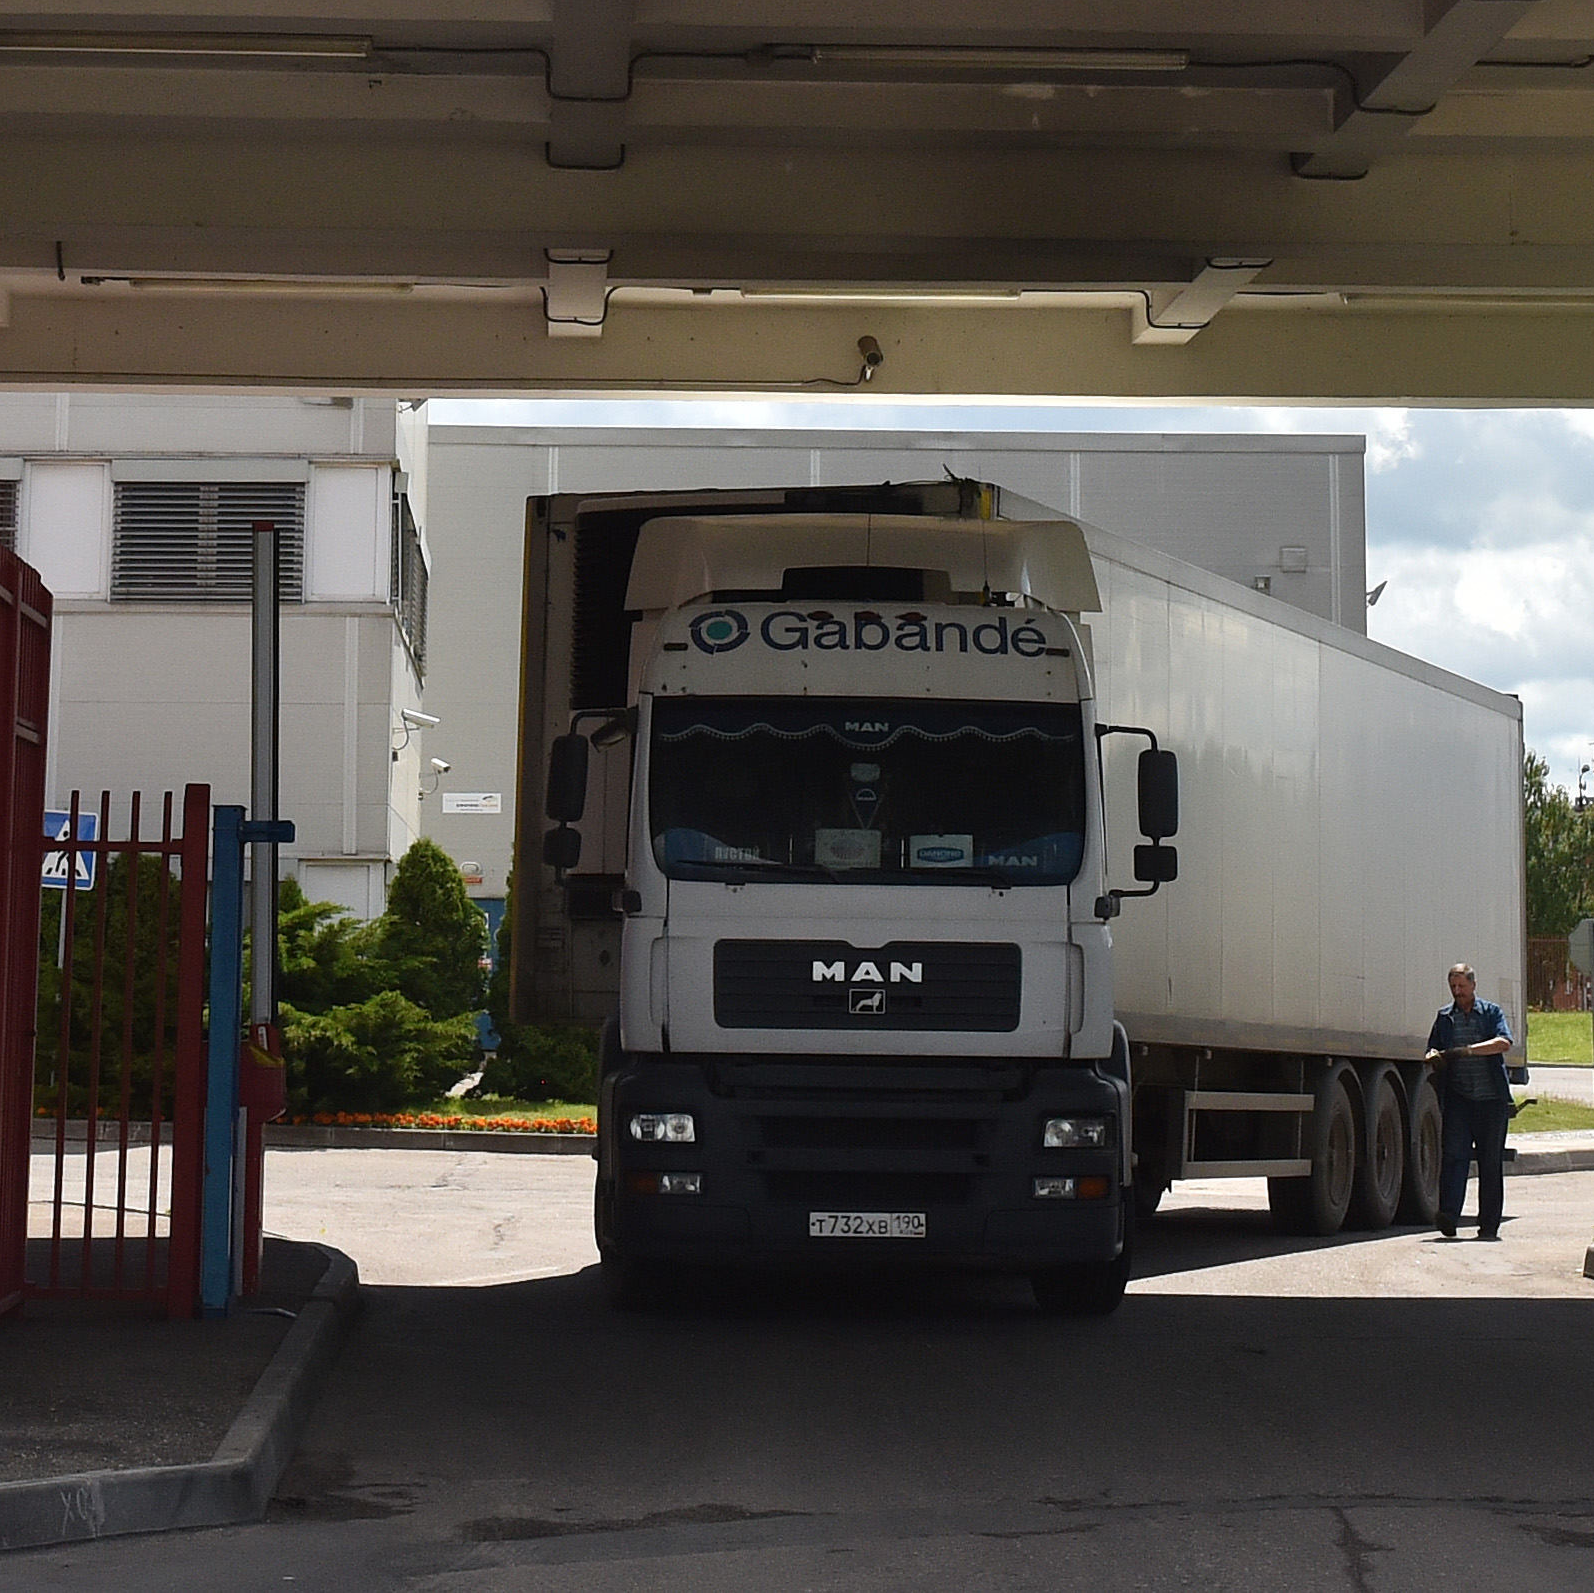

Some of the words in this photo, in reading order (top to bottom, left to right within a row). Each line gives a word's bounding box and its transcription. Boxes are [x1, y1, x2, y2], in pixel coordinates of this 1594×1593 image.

[760, 610, 1046, 658] Gabandé
[844, 721, 889, 732] MAN
[988, 855, 1038, 866] MAN
[812, 961, 923, 983] MAN
[894, 1215, 921, 1229] 190
